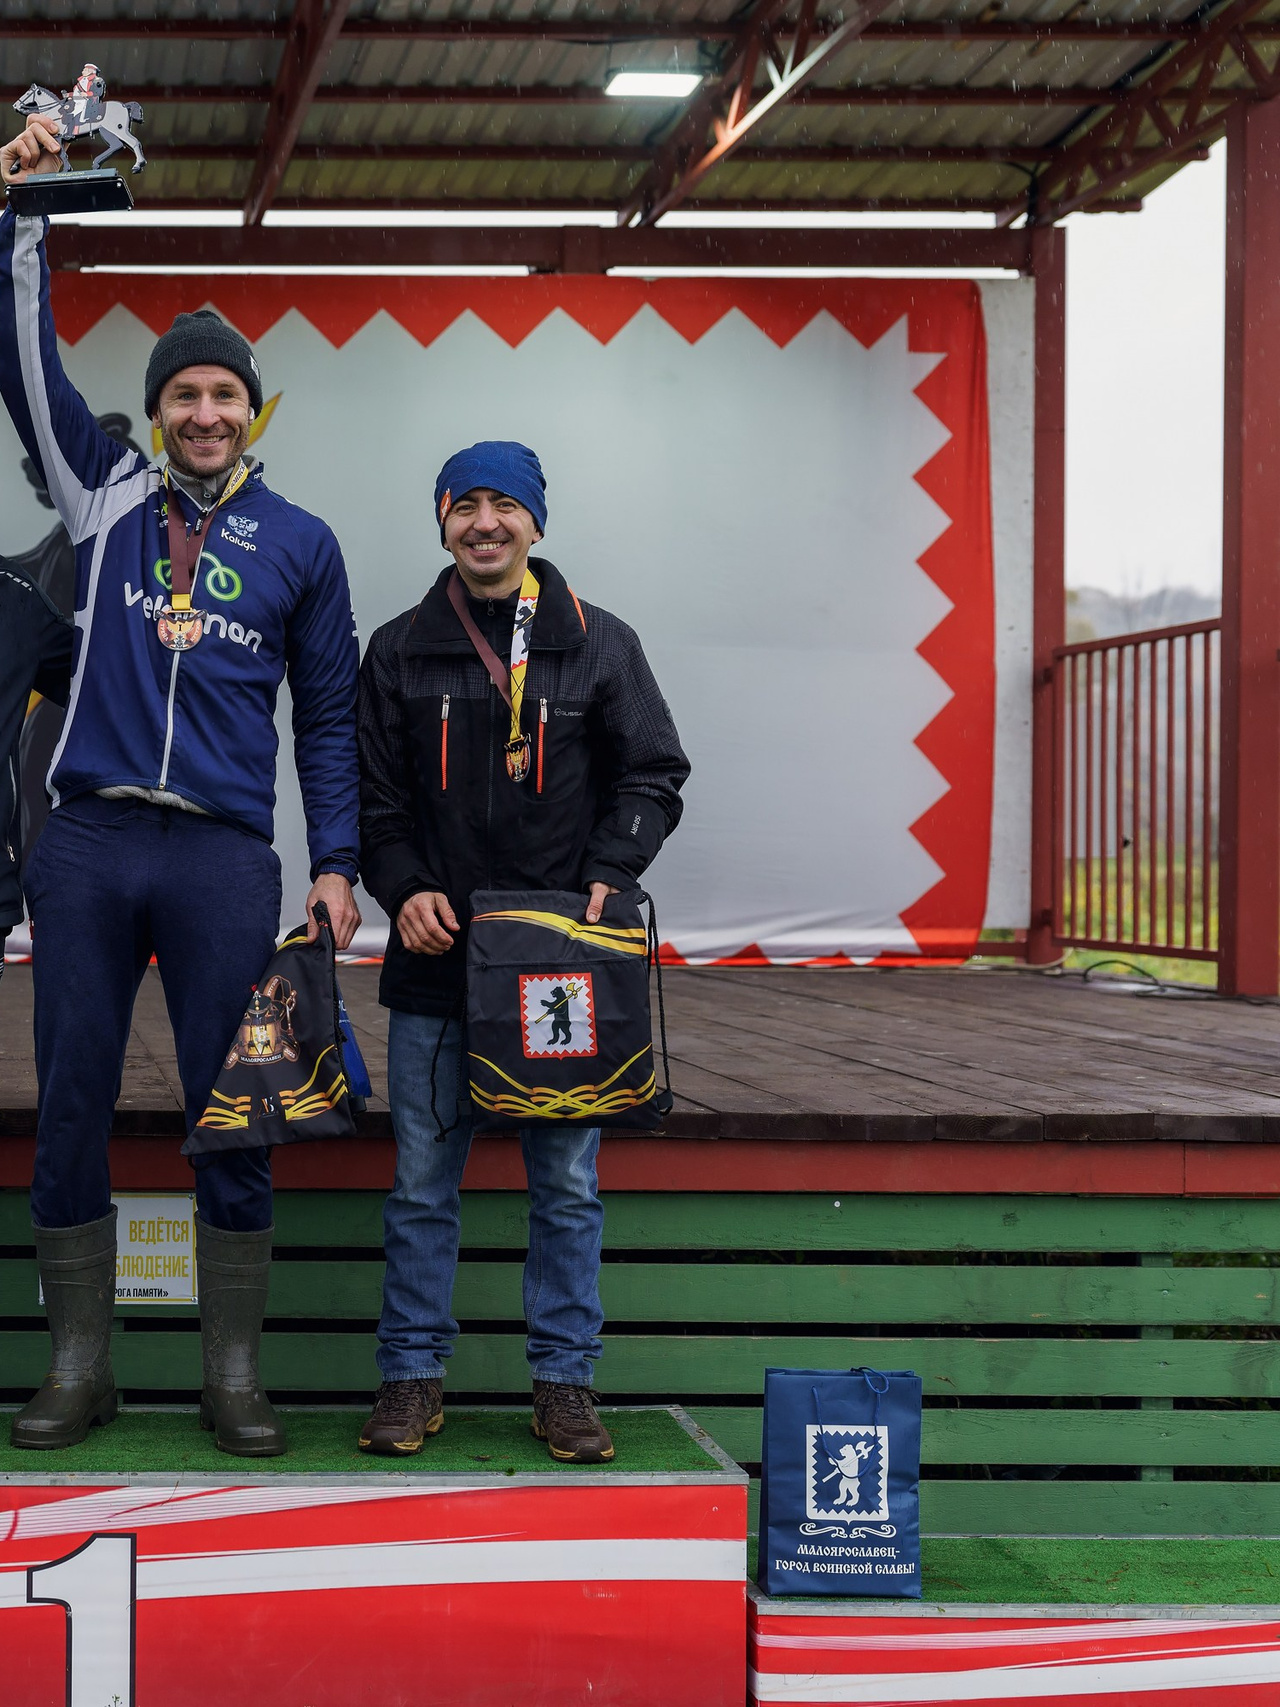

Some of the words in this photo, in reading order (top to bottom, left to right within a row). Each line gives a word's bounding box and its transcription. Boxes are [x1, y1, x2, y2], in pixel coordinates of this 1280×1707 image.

[221, 528, 257, 552] Kaluga
[129, 1216, 189, 1245] ВЕДЁТСЯ
[116, 1255, 189, 1280] БЛЮДЕНИЕ
[115, 1288, 131, 1297] РОГА
[132, 1288, 169, 1297] ПАМЯТИ»
[797, 1544, 901, 1559] МАЛОЯРОСЛАВЕЦ-
[775, 1559, 811, 1573] ГОРОД
[812, 1562, 873, 1575] ВОИНСКОЙ
[875, 1562, 915, 1575] СЛАВЫ!
[26, 1532, 137, 1707] 1
